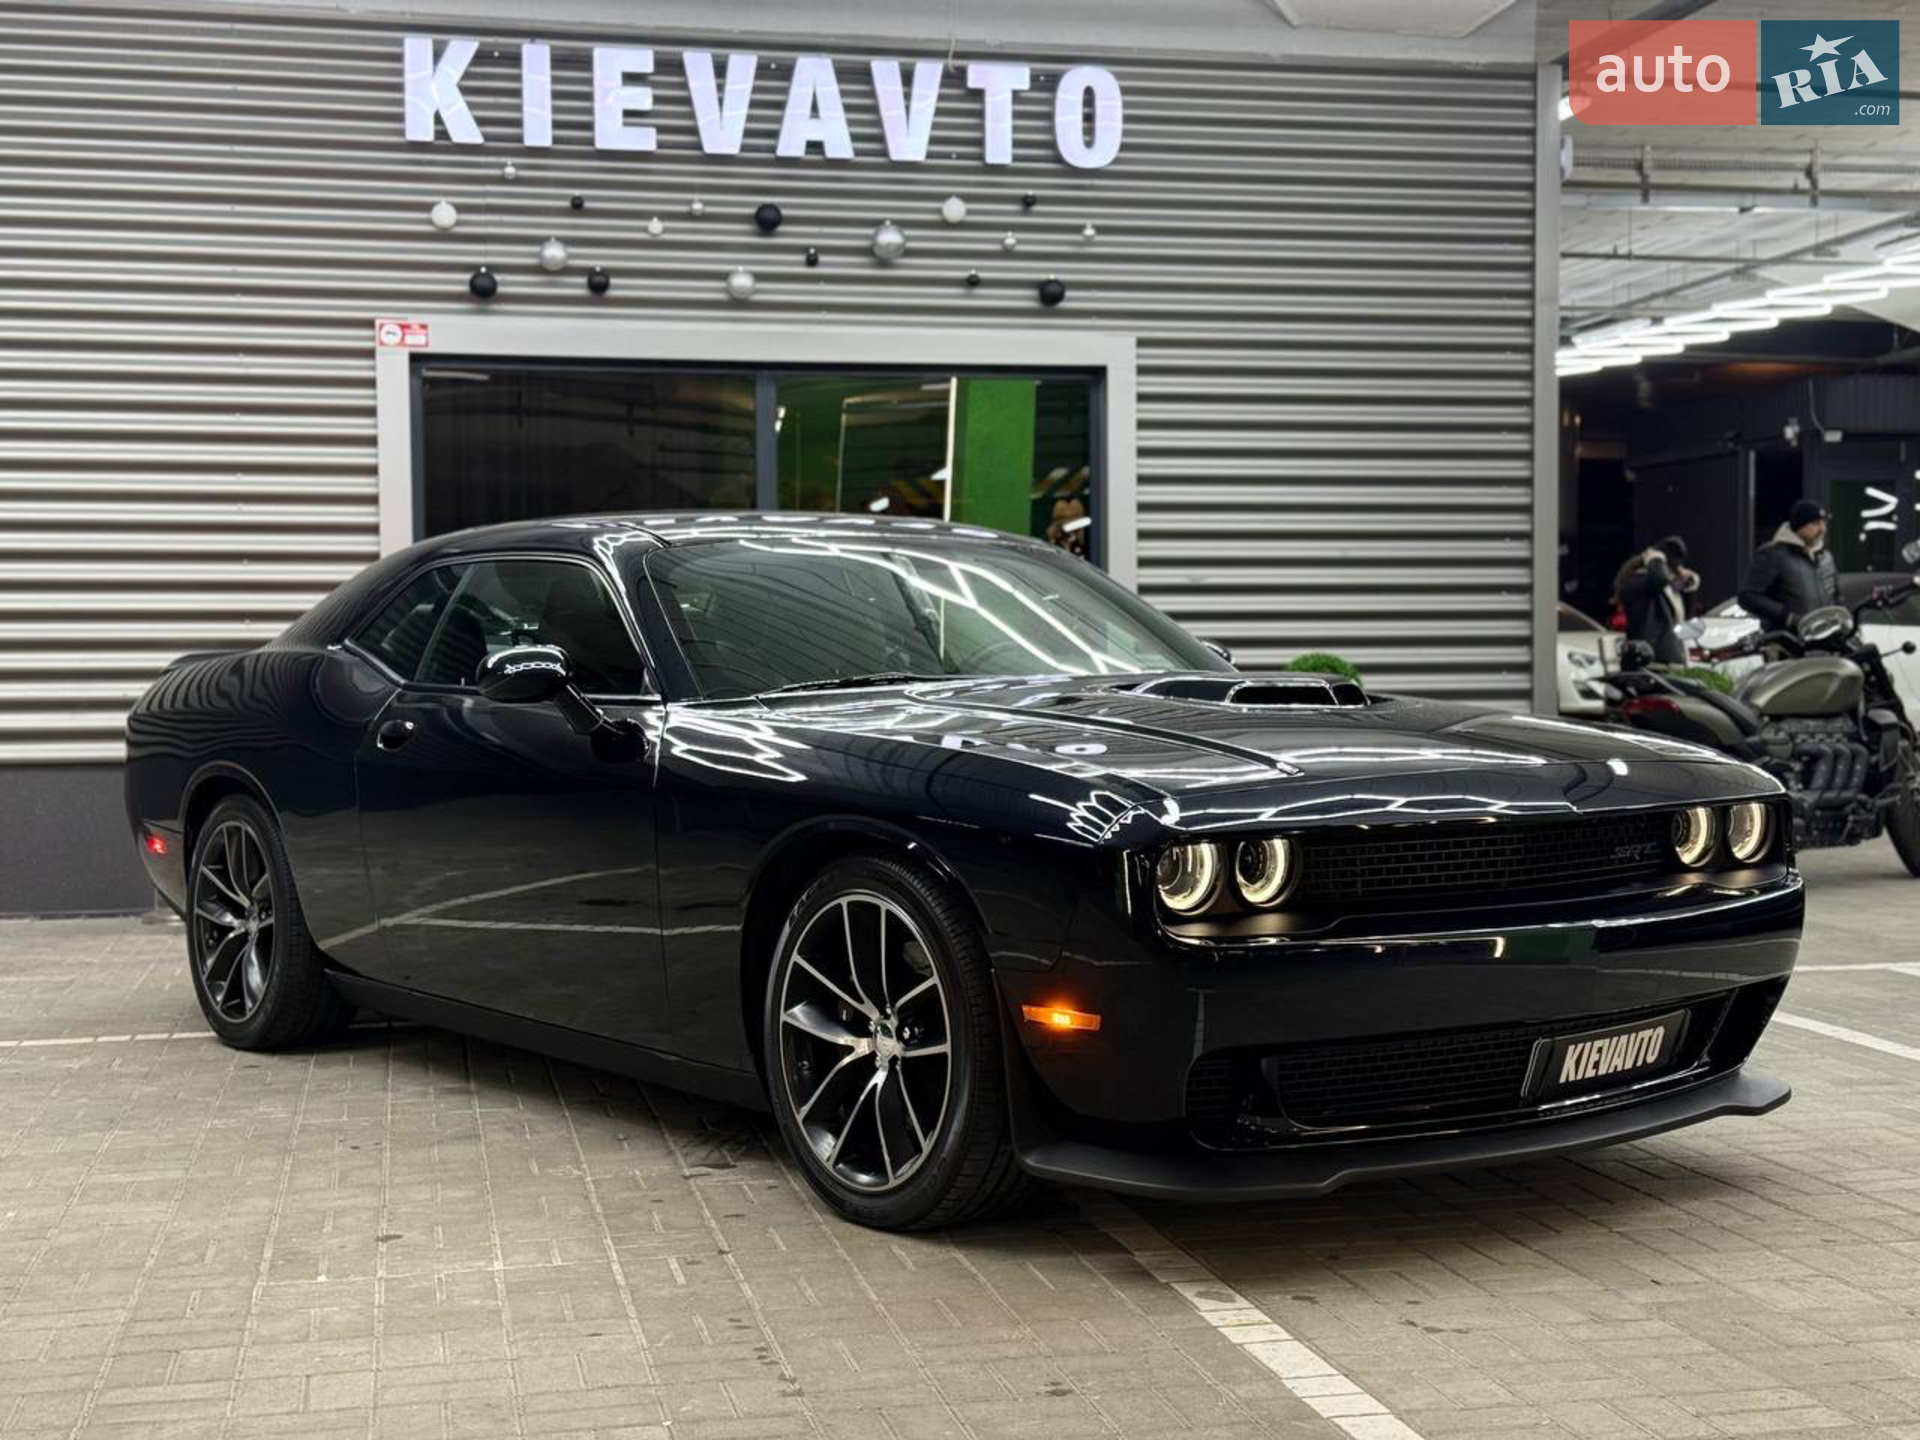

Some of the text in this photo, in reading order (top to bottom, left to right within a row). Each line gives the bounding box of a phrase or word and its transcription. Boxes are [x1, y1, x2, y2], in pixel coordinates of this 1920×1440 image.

[403, 36, 1124, 169] KIEVAVTO
[1610, 842, 1657, 860] SRT
[1559, 1026, 1665, 1084] KIEVAVTO
